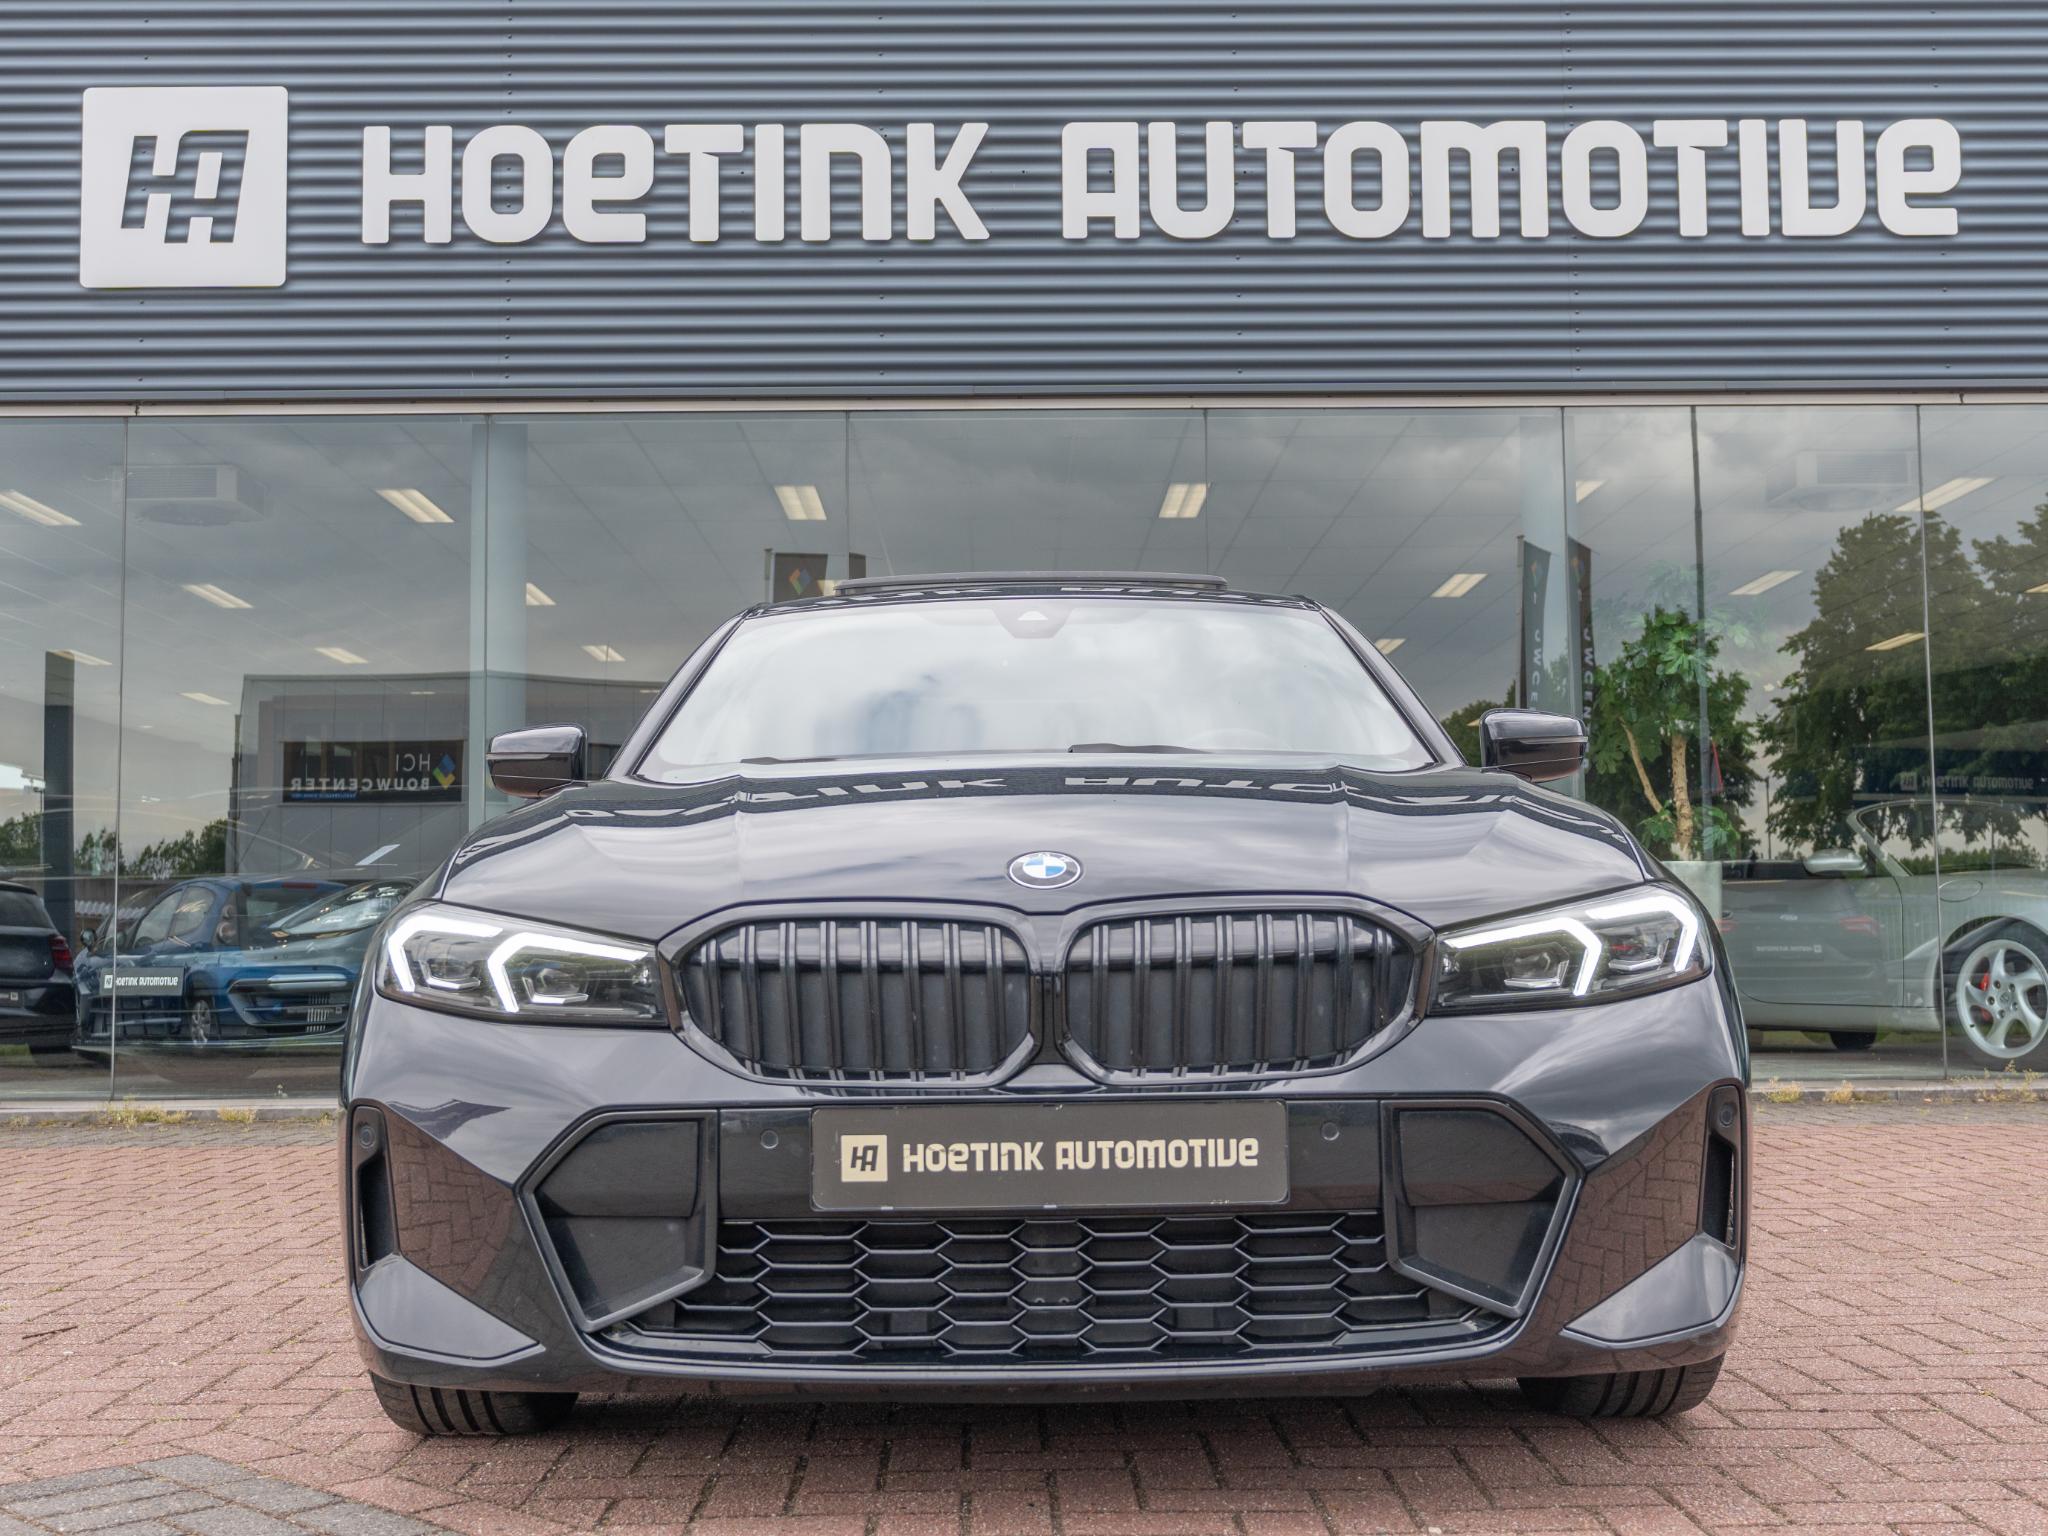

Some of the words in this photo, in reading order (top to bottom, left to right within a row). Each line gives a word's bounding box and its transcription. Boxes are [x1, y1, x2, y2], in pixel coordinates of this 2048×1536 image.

[362, 122, 991, 245] HOETINK
[1061, 118, 1962, 240] AUTOMOTIVE
[902, 1141, 1044, 1173] HOETINK
[1055, 1137, 1259, 1170] AUTOMOTIVE
